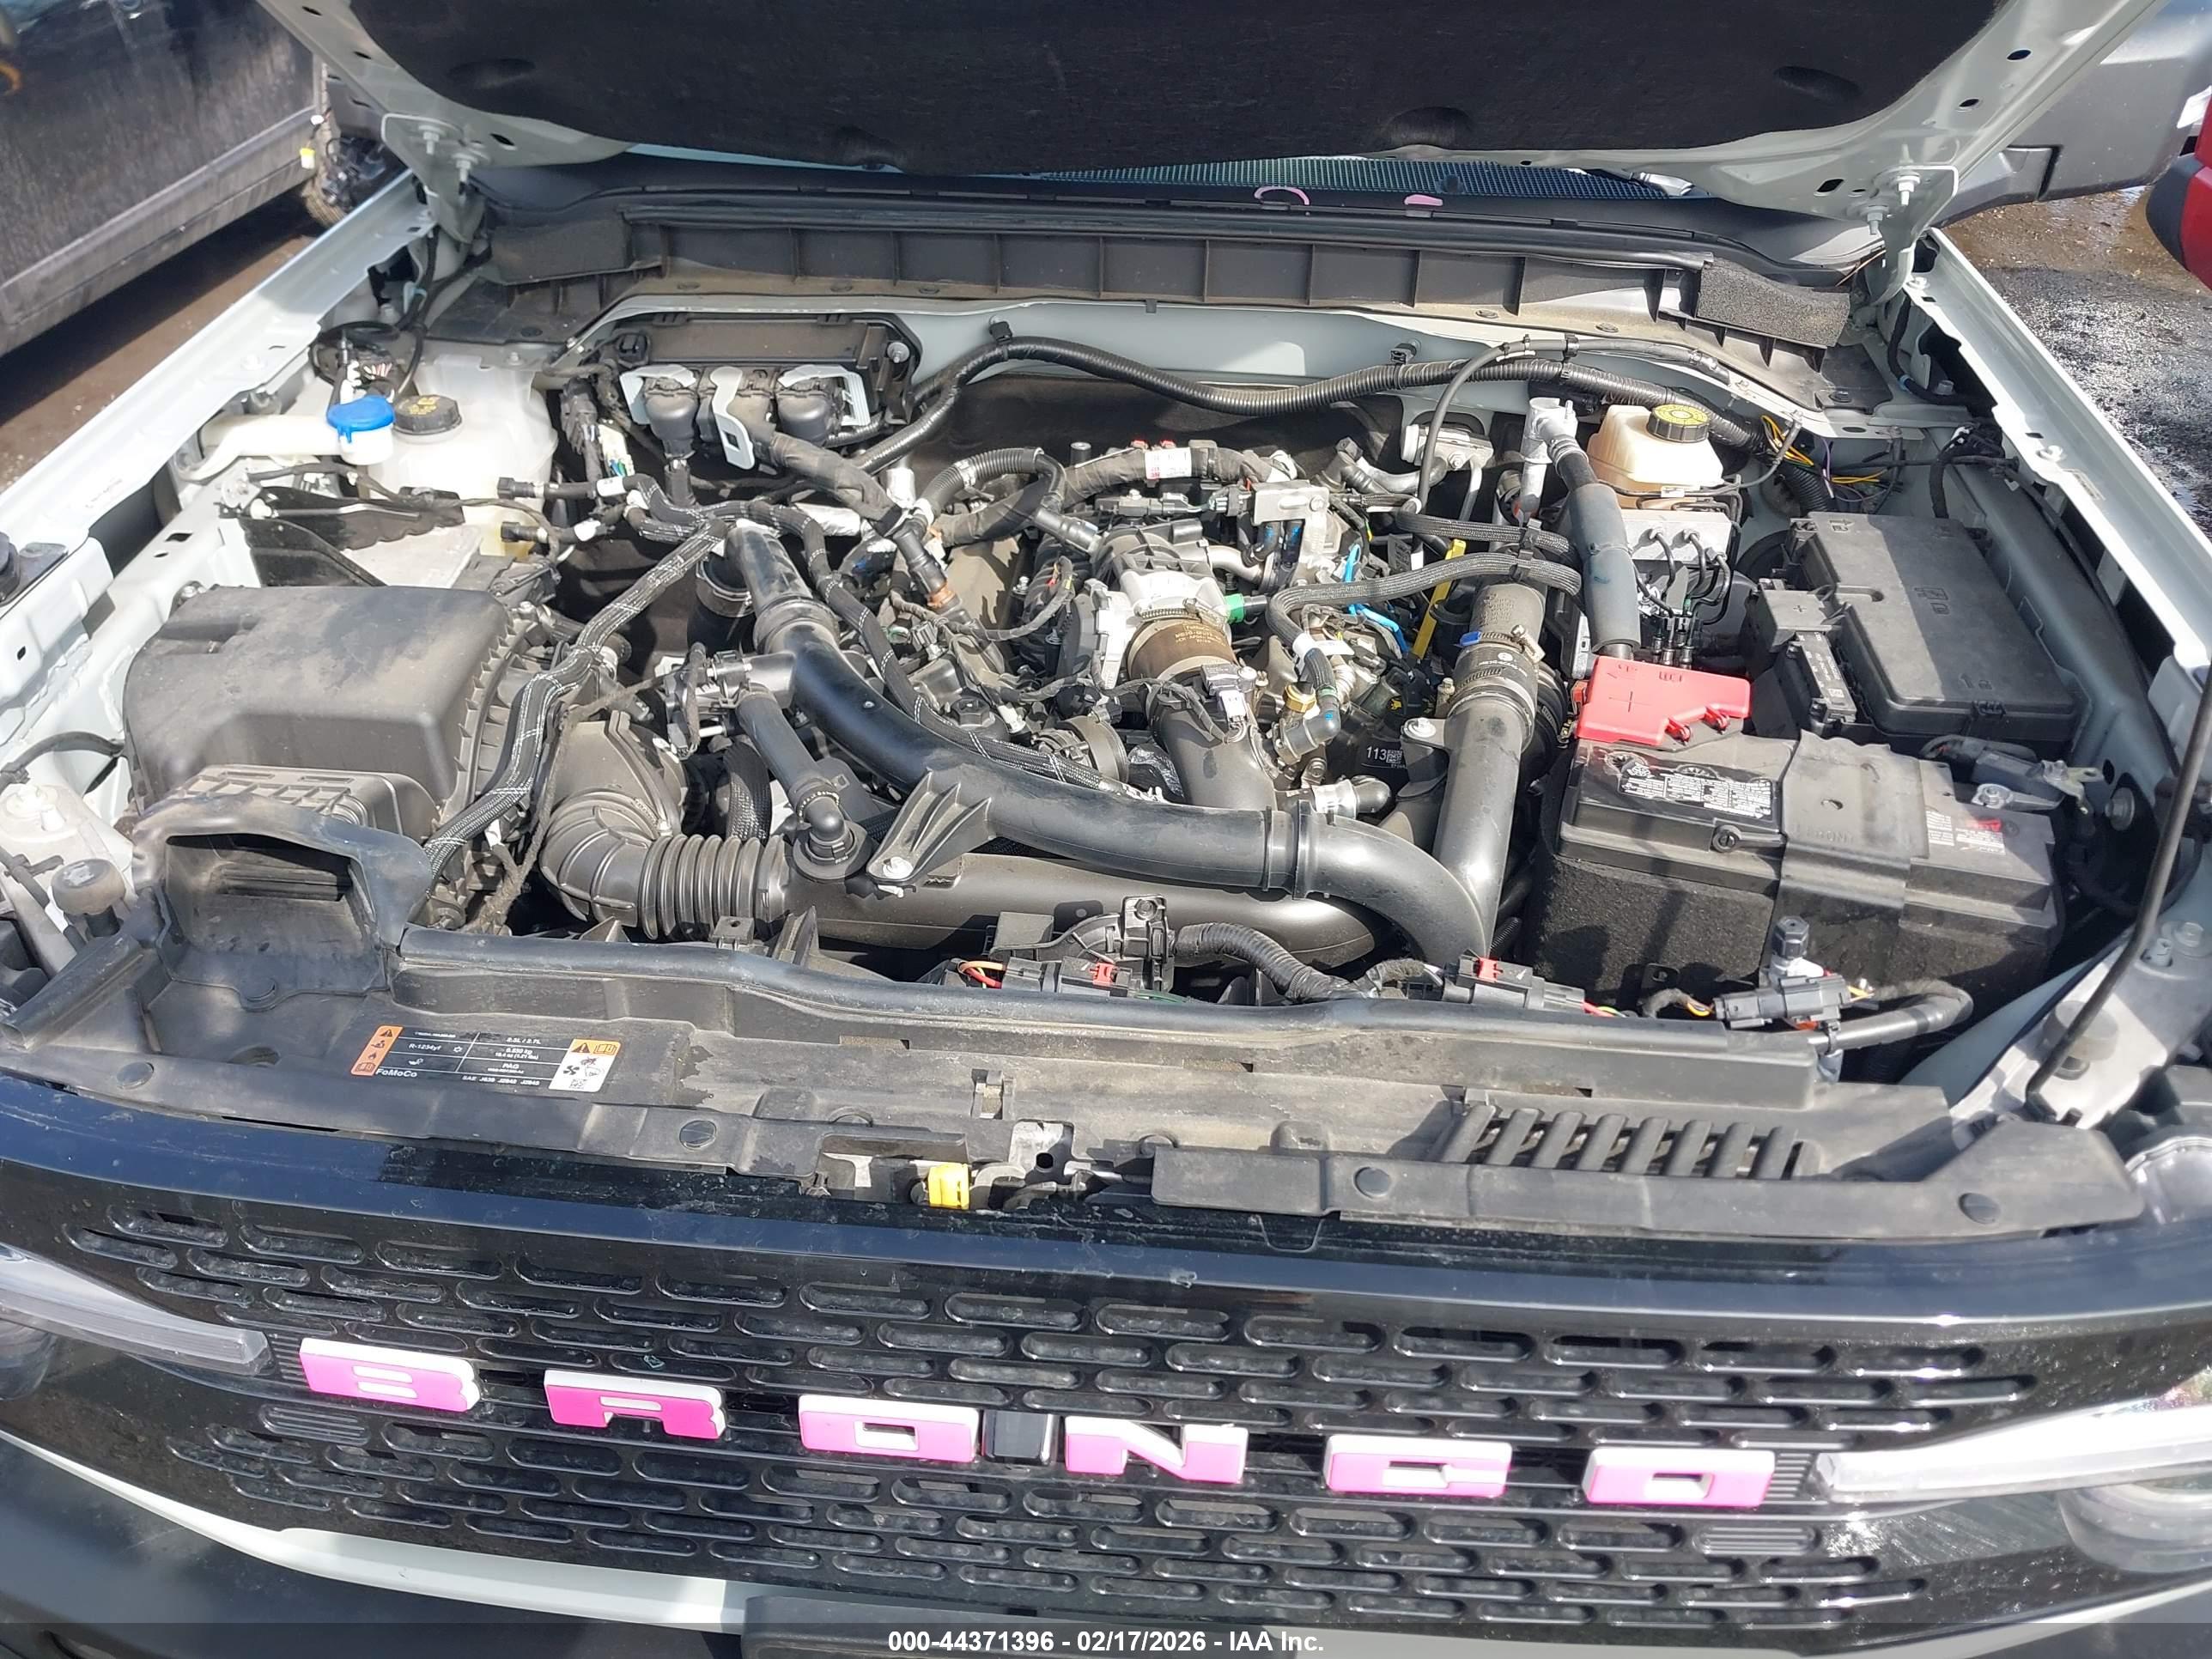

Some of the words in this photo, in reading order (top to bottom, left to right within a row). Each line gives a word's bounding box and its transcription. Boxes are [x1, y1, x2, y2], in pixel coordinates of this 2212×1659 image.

[1367, 746, 1386, 760] 113
[375, 1069, 417, 1078] FoMoCo
[299, 1336, 1775, 1509] BRONCO
